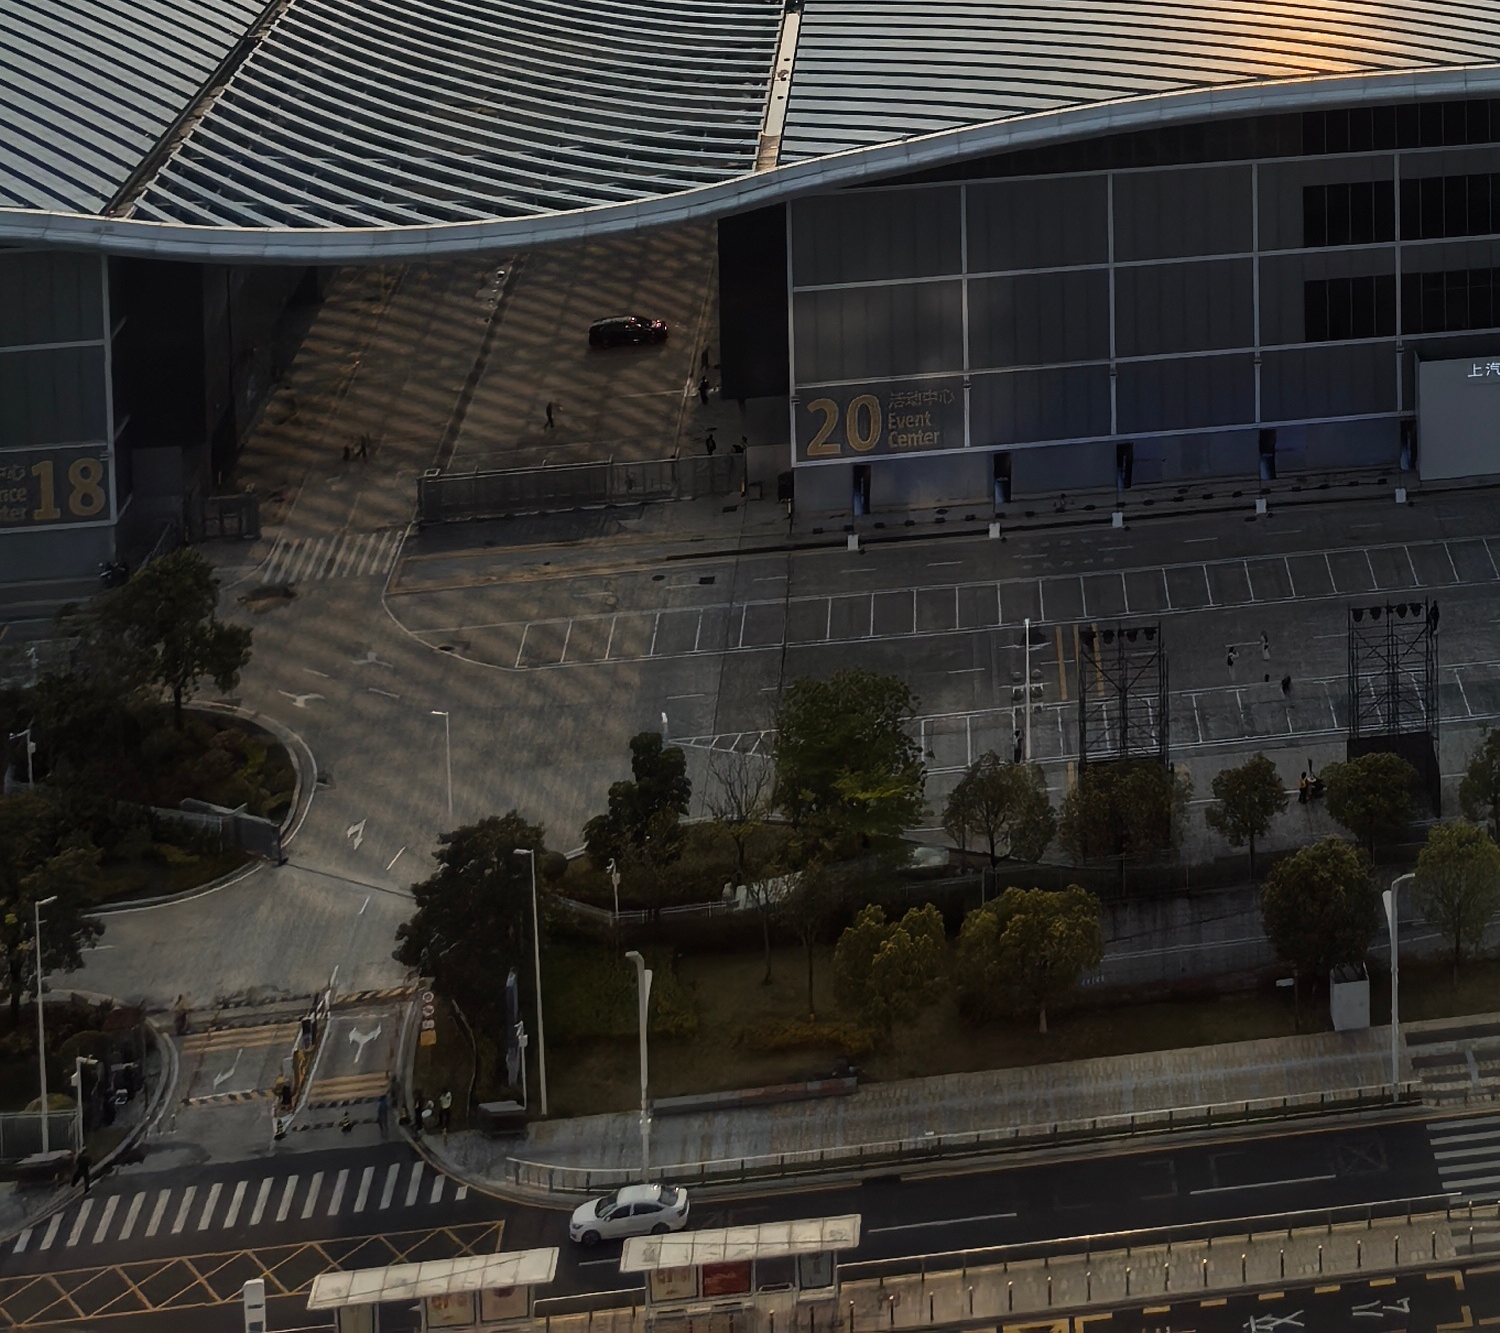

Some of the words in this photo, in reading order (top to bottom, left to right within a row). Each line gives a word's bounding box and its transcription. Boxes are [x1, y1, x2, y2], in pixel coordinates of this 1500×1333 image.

[806, 393, 882, 457] 20
[887, 410, 932, 430] Event
[887, 428, 940, 449] Center
[31, 456, 106, 521] 18
